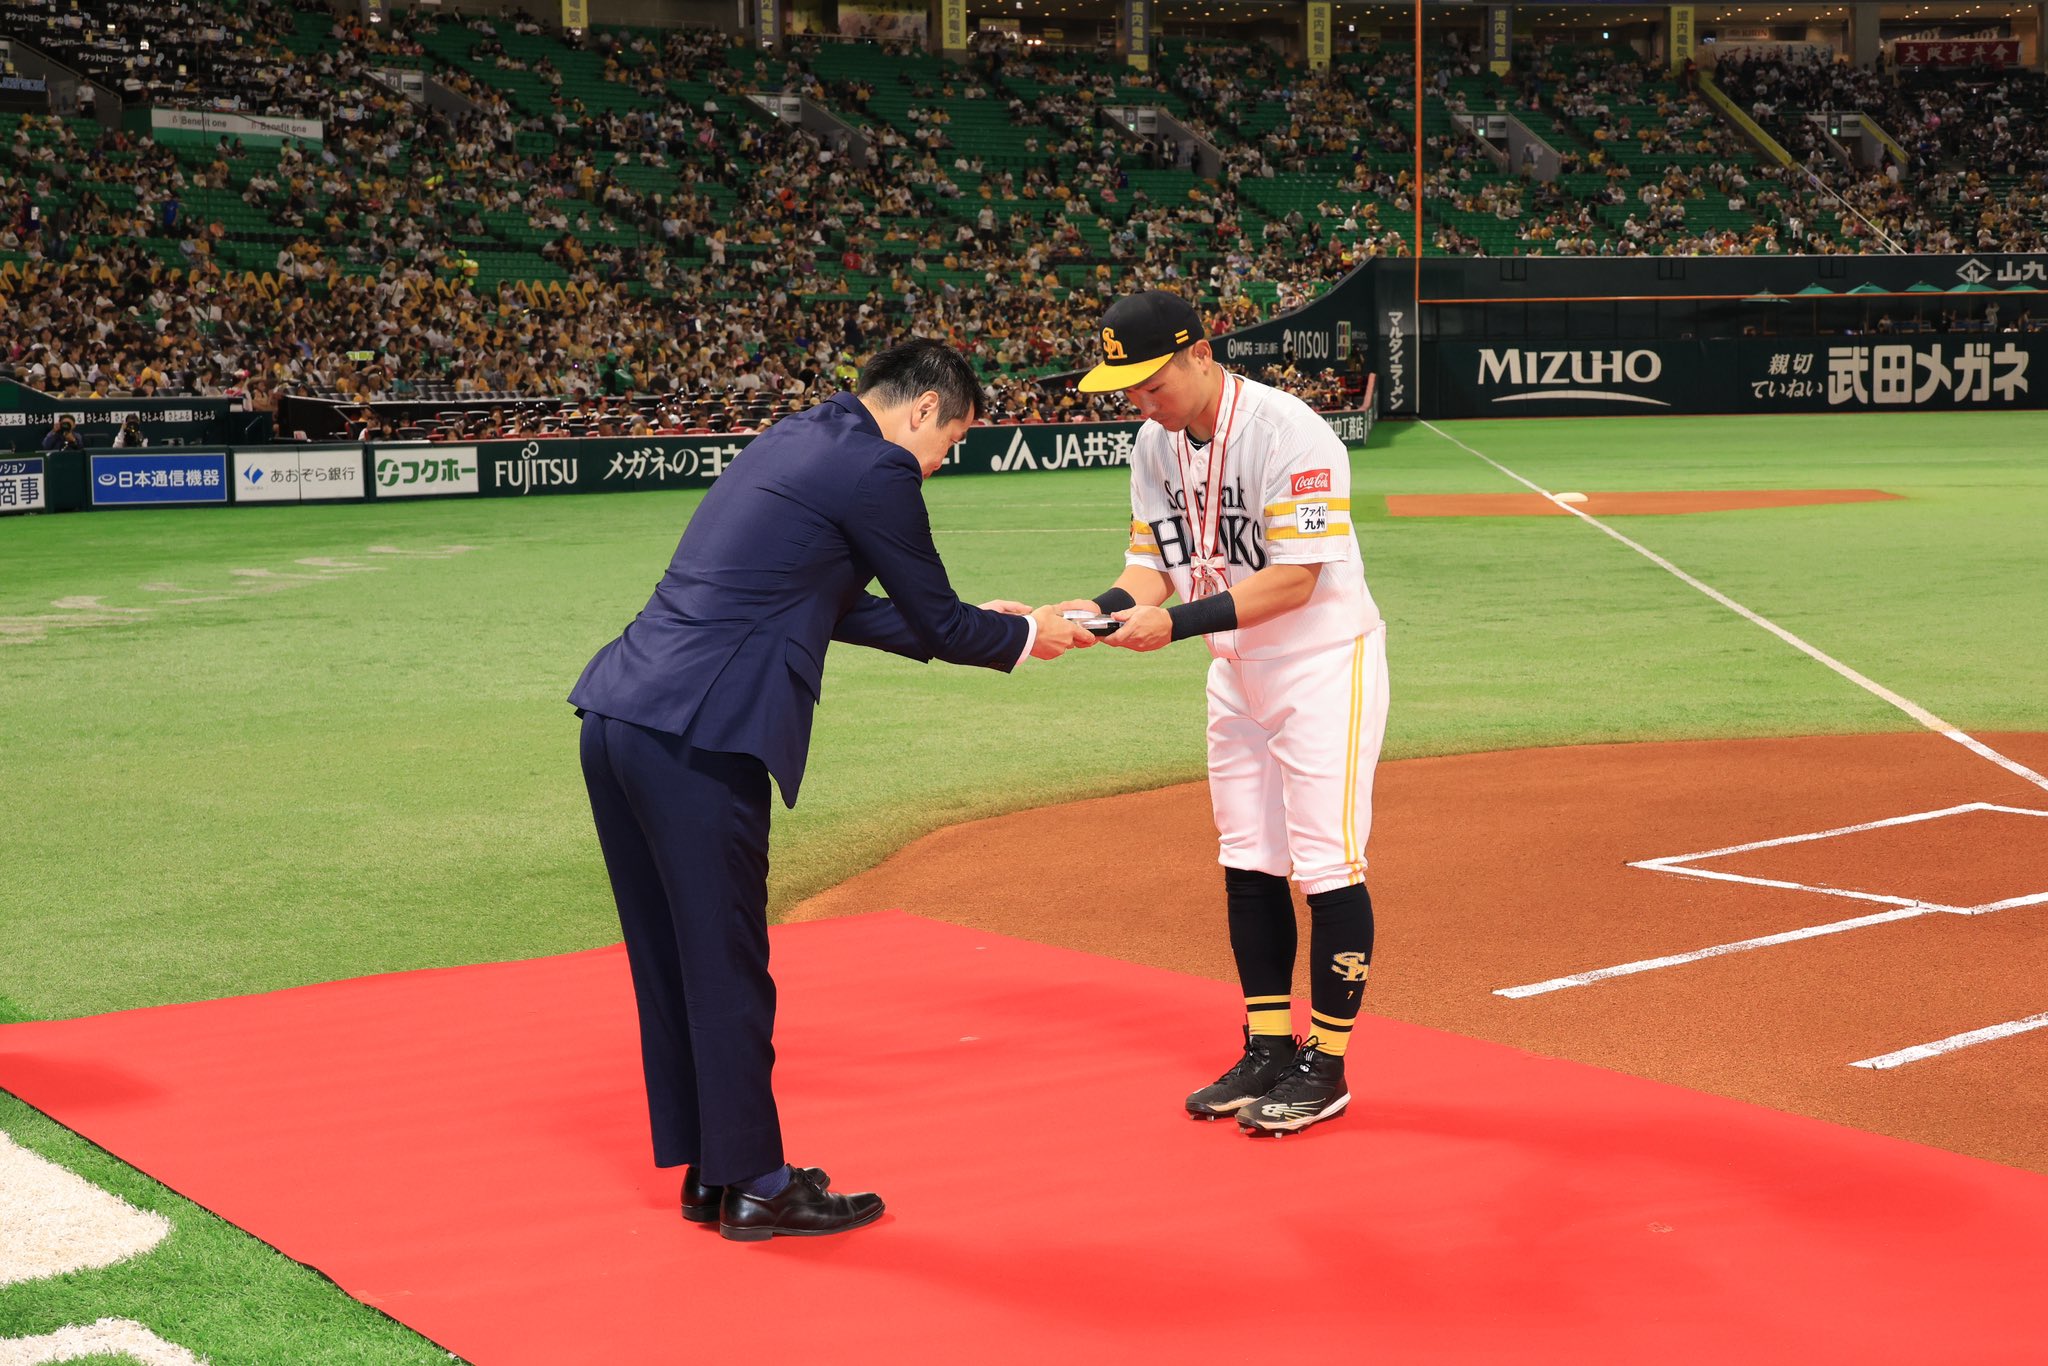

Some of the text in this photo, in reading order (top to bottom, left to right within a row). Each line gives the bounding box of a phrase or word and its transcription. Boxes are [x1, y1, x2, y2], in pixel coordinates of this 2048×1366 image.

[1997, 261, 2048, 282] 山九
[1388, 311, 1404, 411] マルタイラーメン
[1477, 347, 1662, 385] MIZUHO
[1768, 353, 1814, 376] 親切
[1828, 342, 2029, 404] 武田メガネ
[1751, 379, 1824, 399] ていねい
[28, 413, 53, 424] さとふる
[86, 412, 111, 423] さとふる
[142, 411, 165, 422] さとふる
[194, 410, 216, 421] さとふる
[1041, 430, 1134, 470] JA共済
[118, 469, 219, 488] 日本通信機器
[270, 466, 356, 483] あおぞら銀行
[495, 455, 578, 494] FUJITSU
[0, 477, 40, 506] 商事
[1304, 518, 1325, 530] 九州
